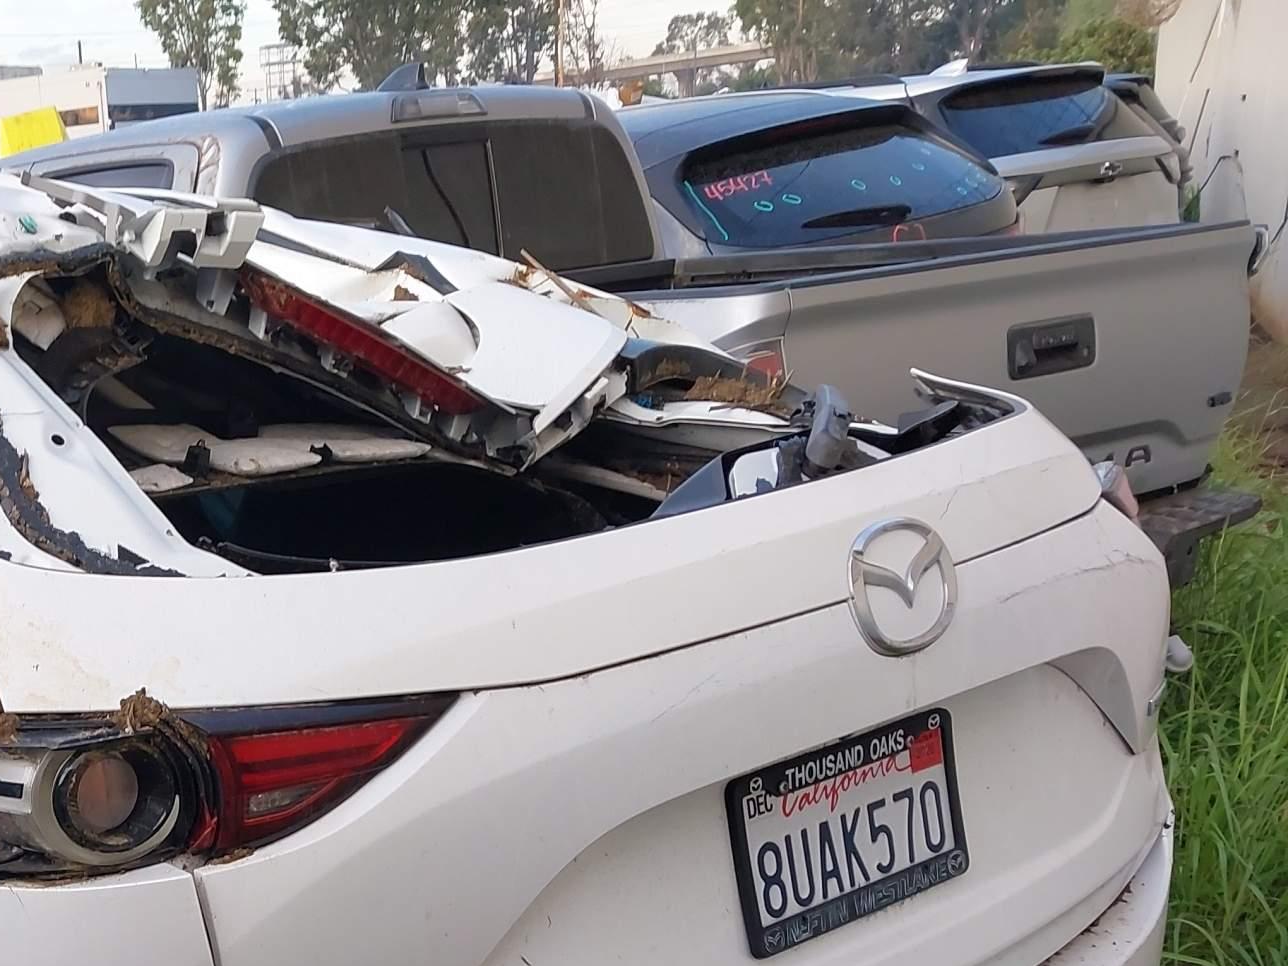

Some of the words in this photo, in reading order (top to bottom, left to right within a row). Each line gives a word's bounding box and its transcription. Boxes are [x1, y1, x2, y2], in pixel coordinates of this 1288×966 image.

[703, 170, 773, 200] 45427
[781, 754, 911, 817] California
[785, 744, 864, 791] THOUSAND
[870, 728, 905, 759] OAKS
[746, 793, 774, 820] DEC
[757, 780, 946, 919] 8UAK570
